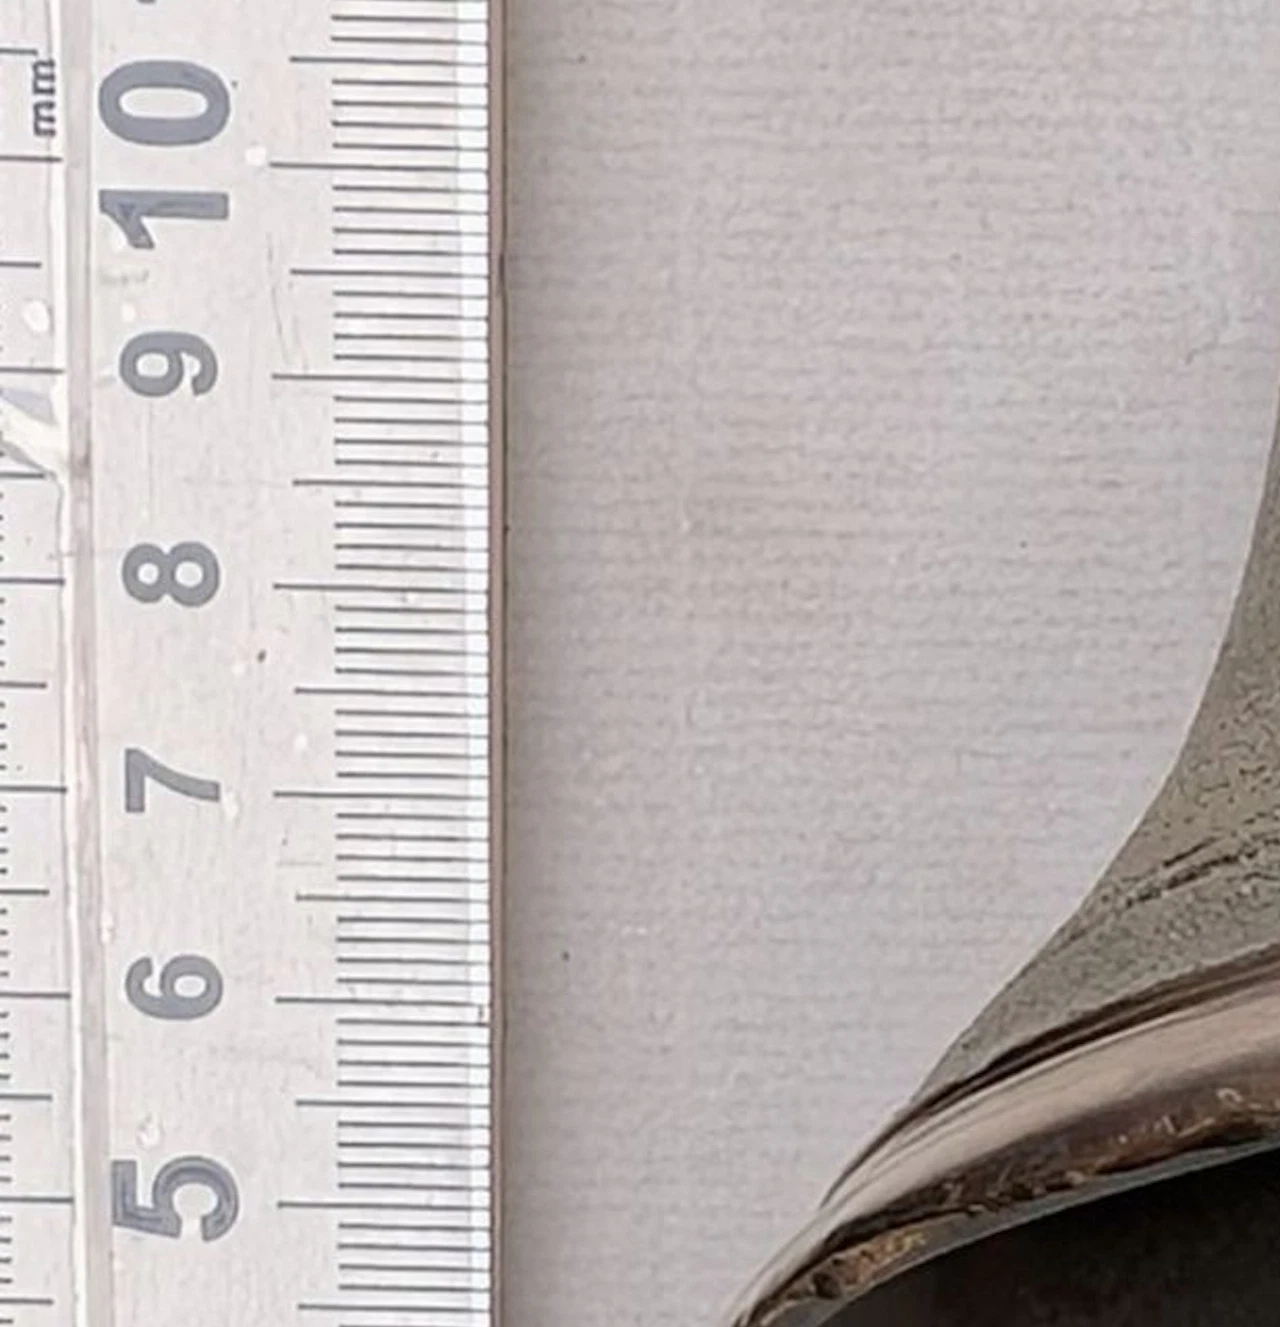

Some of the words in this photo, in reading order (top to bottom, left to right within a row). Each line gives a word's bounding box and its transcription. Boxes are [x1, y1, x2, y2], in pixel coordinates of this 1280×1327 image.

[32, 58, 56, 137] mm
[98, 60, 231, 251] 10
[118, 331, 219, 398] 9
[121, 541, 221, 608] 8
[124, 747, 222, 814] 7
[124, 954, 224, 1022] 6
[110, 1155, 240, 1243] 5
